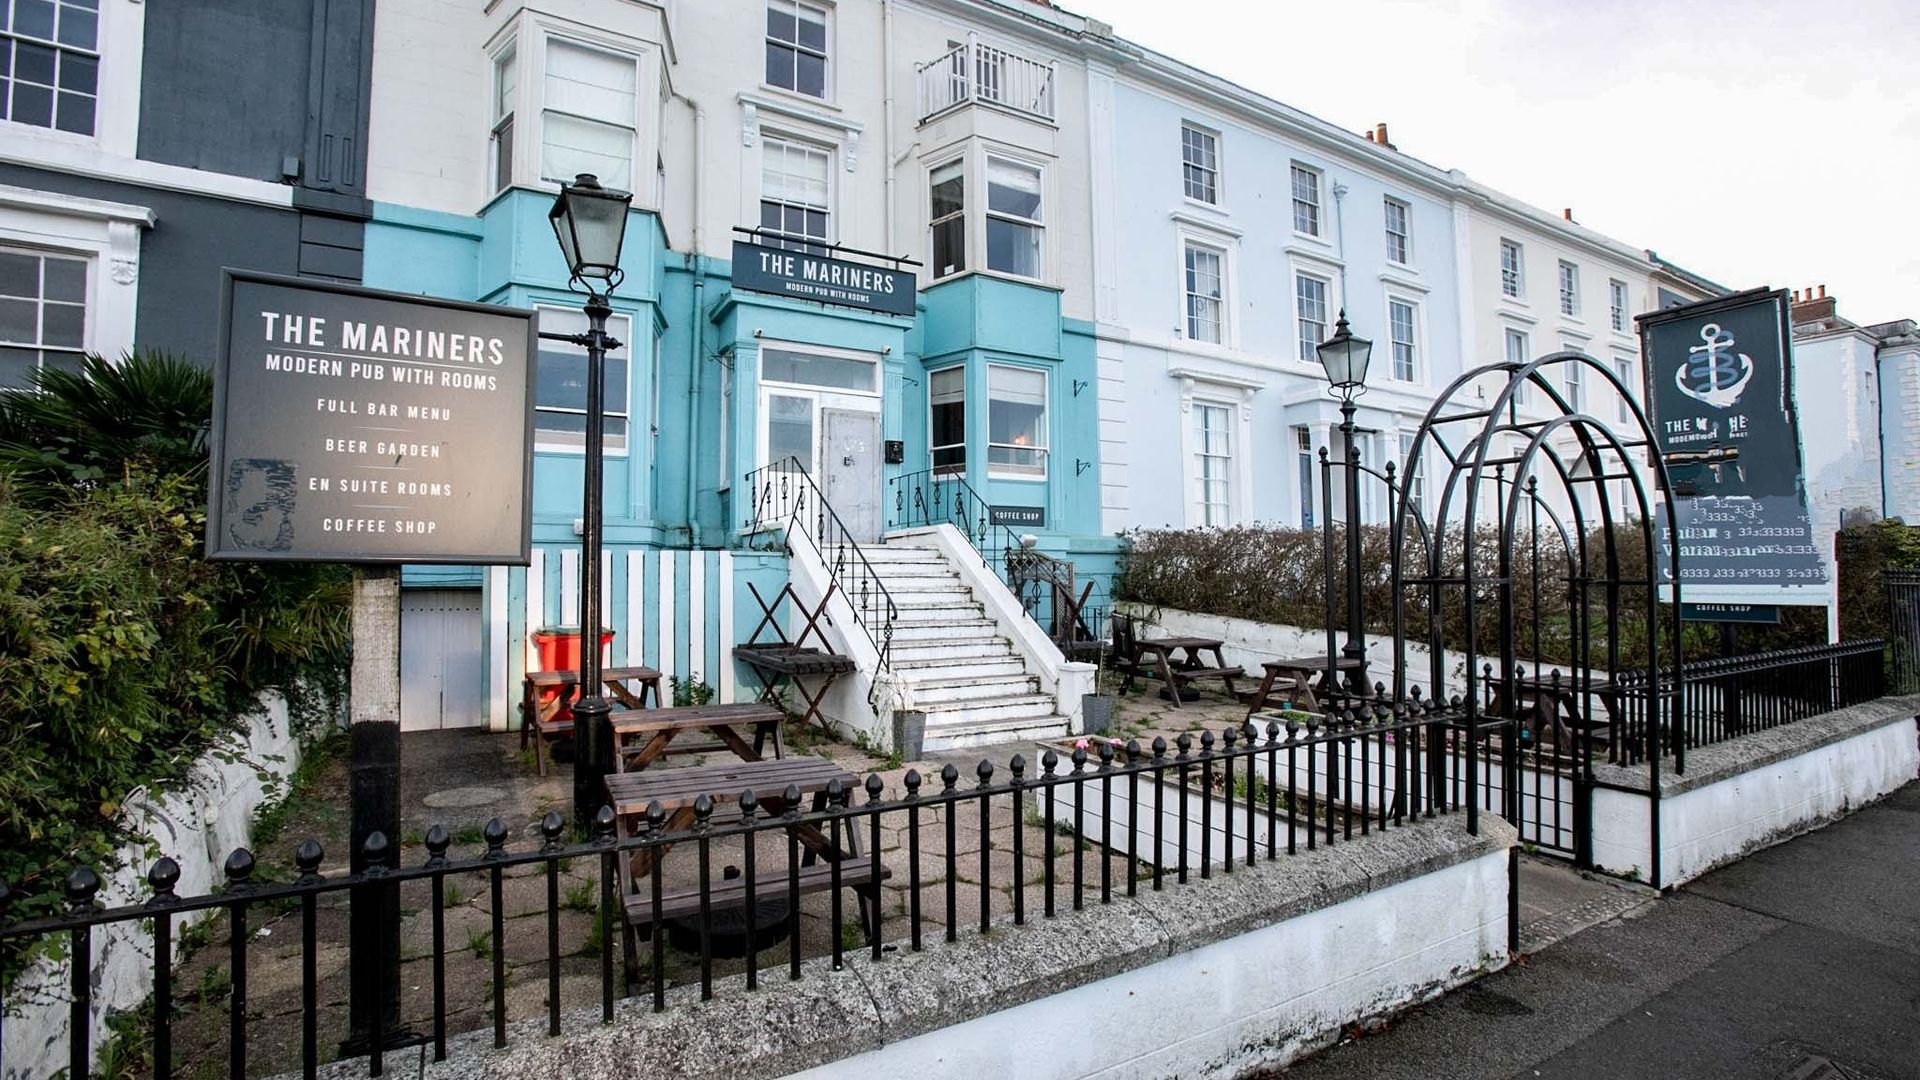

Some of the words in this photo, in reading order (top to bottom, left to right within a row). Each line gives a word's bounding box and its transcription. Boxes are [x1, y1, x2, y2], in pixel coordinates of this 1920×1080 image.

[759, 252, 795, 277] THE
[803, 259, 894, 294] MARINERS
[785, 282, 813, 294] MODERN
[815, 286, 828, 296] PUB
[829, 289, 847, 299] WITH
[847, 292, 870, 303] ROOMS
[261, 311, 326, 347] THE
[342, 321, 504, 366] MARINERS
[265, 354, 342, 377] MODERN
[350, 362, 384, 380] PUB
[392, 366, 434, 386] WITH
[441, 371, 497, 391] ROOMS
[317, 398, 358, 415] FULL
[367, 403, 398, 417] BAR
[407, 406, 451, 421] MENU
[1665, 418, 1691, 433] THE
[325, 439, 367, 454] BEER
[377, 442, 440, 459] GARDEN
[309, 478, 330, 492] EN
[340, 479, 389, 494] SUITE
[398, 483, 452, 497] ROOMS
[995, 511, 1020, 519] COFFEE
[1022, 512, 1039, 520] SHOP
[323, 518, 386, 533] COFFEE
[395, 521, 436, 534] SHOP
[1696, 604, 1726, 612] COFFEE
